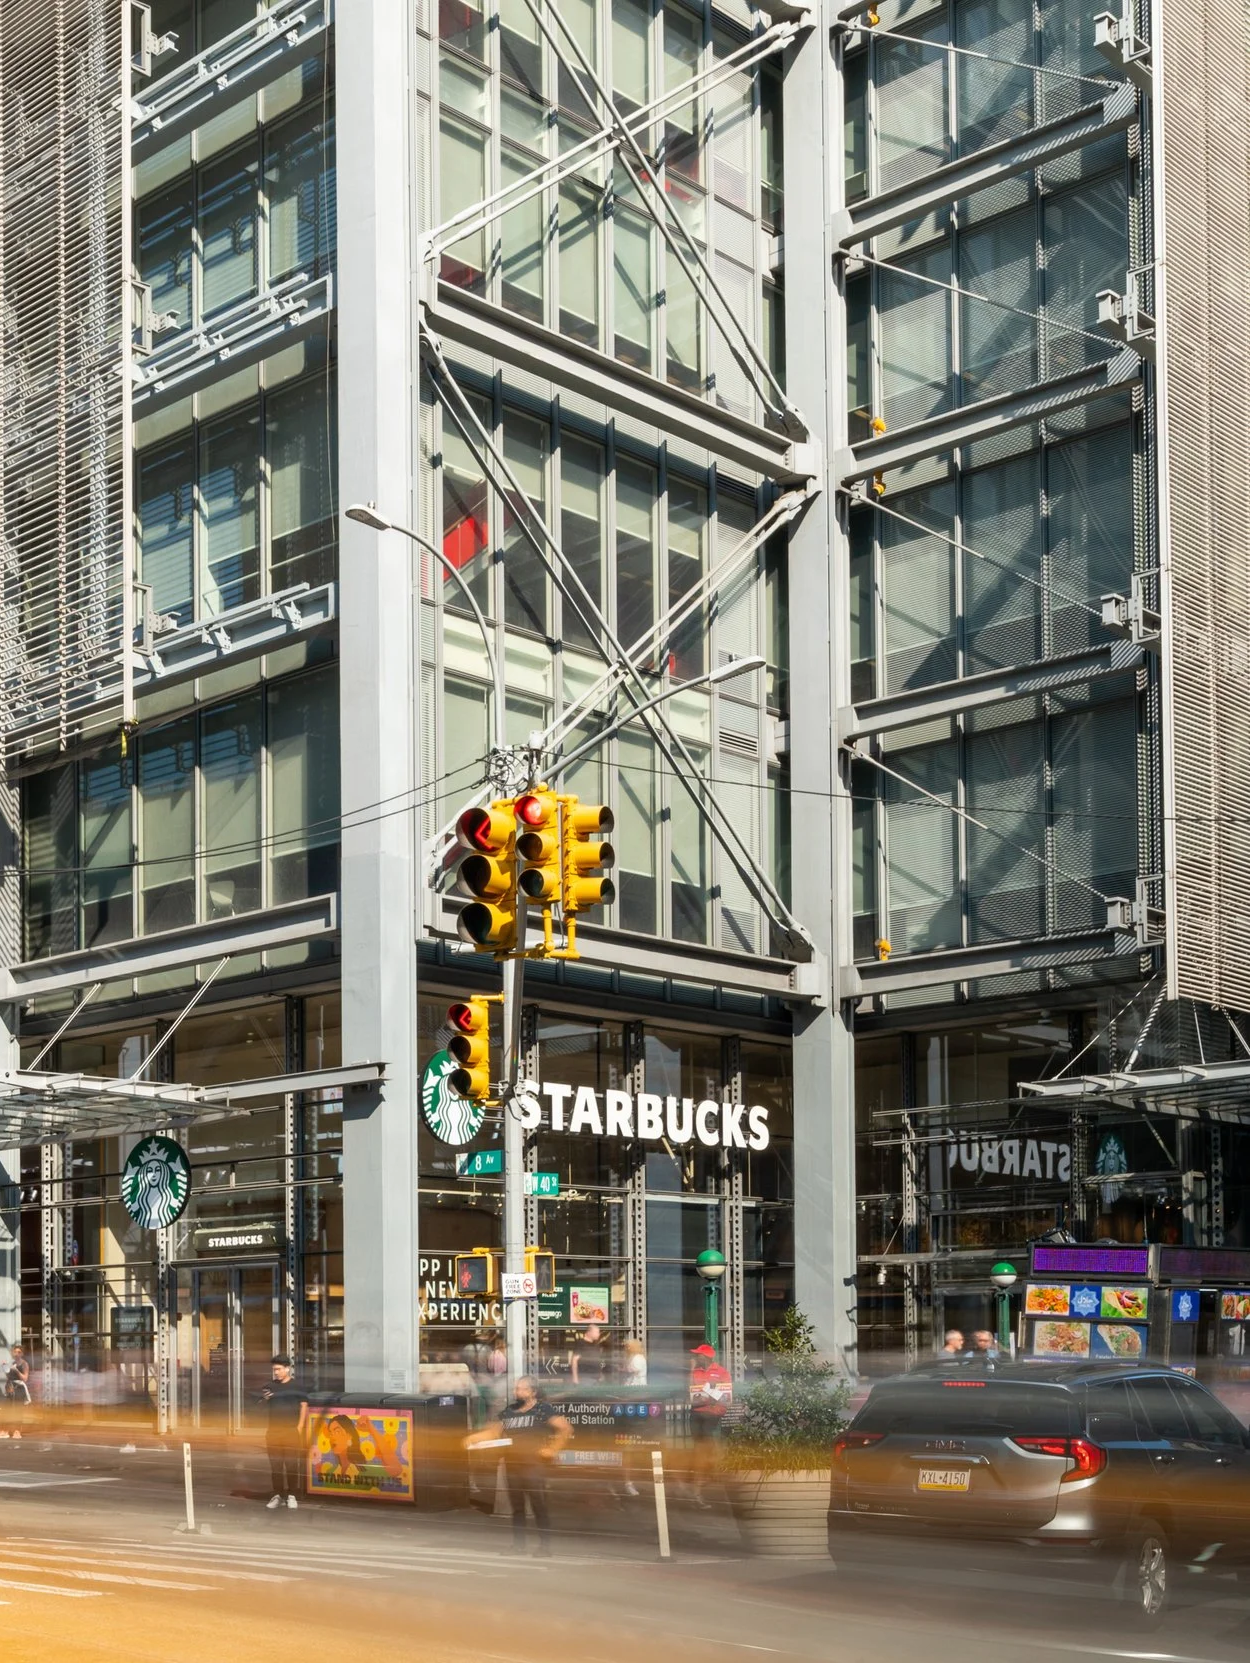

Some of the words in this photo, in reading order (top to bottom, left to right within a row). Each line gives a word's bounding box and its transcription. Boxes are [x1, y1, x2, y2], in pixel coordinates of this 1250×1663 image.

[521, 1079, 769, 1151] STARBUCKS
[474, 1154, 482, 1171] 8
[485, 1154, 494, 1164] Av
[540, 1175, 550, 1192] 40
[208, 1235, 263, 1248] STARBUCKS
[568, 1403, 611, 1416] Authority
[581, 1415, 615, 1425] Station
[574, 1450, 594, 1460] FREE
